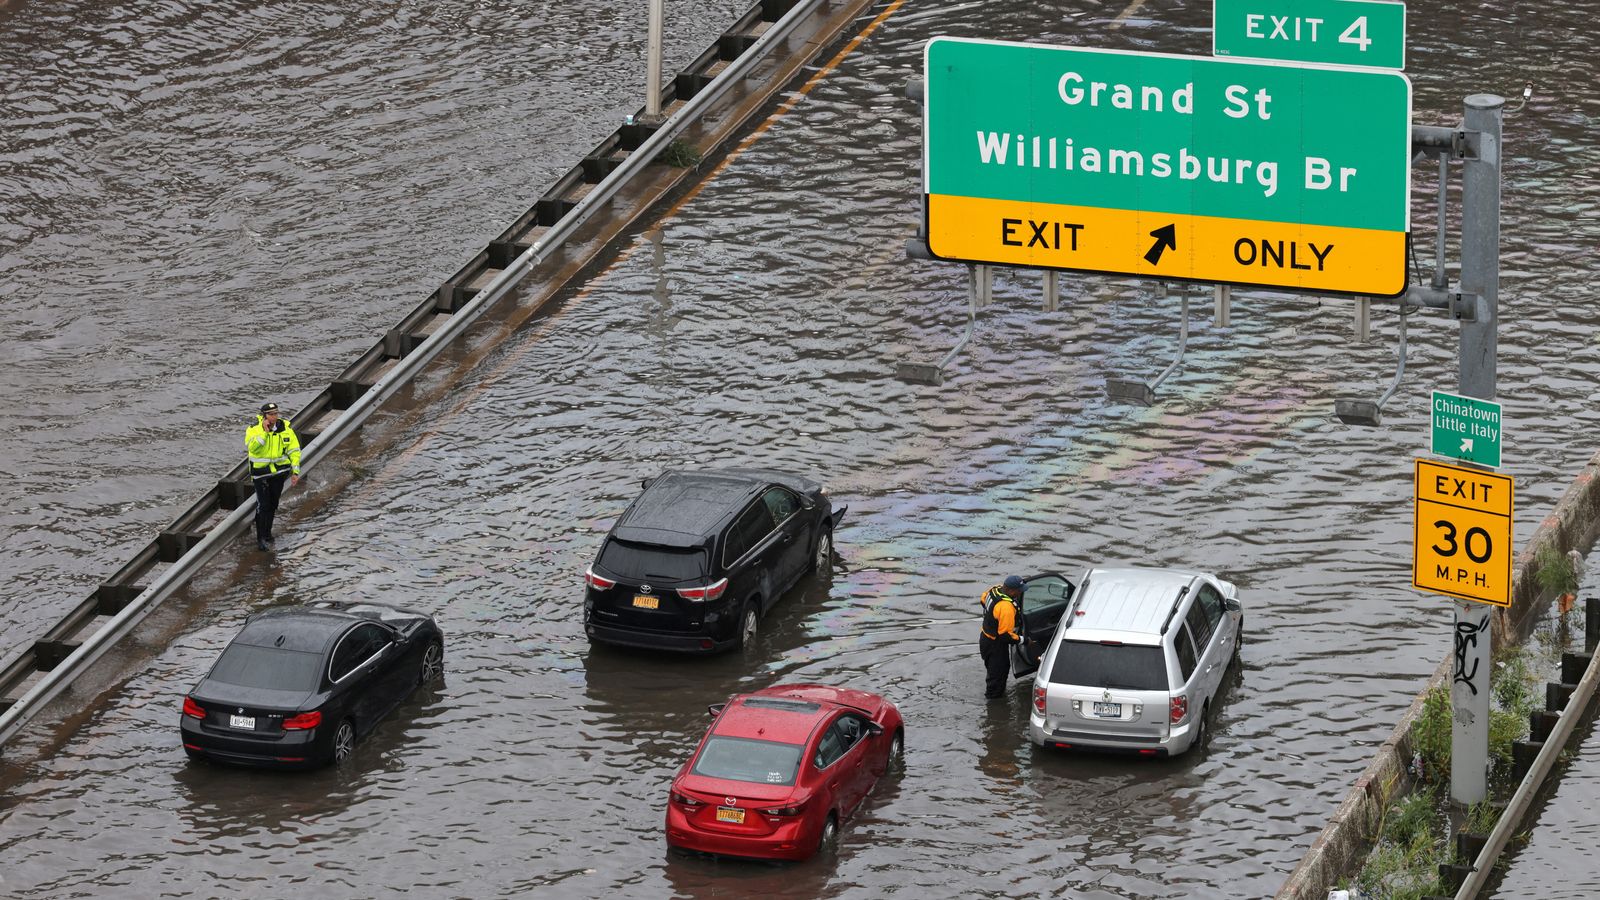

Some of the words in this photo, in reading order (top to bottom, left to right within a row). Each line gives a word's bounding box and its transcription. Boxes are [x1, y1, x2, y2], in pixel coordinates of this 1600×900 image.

[1246, 13, 1324, 42] EXIT
[1338, 16, 1372, 51] 4
[1058, 72, 1193, 114] Grand
[1223, 84, 1272, 120] St
[976, 131, 1278, 197] Williamsburg
[1304, 156, 1357, 192] Br
[1002, 218, 1084, 251] EXIT
[1233, 237, 1335, 271] ONLY
[1435, 398, 1499, 423] Chinatown
[1436, 415, 1466, 433] Little
[1471, 422, 1498, 443] Italy
[1436, 475, 1493, 502] EXIT
[1431, 520, 1493, 564] 30
[1436, 564, 1490, 588] M.P.H.
